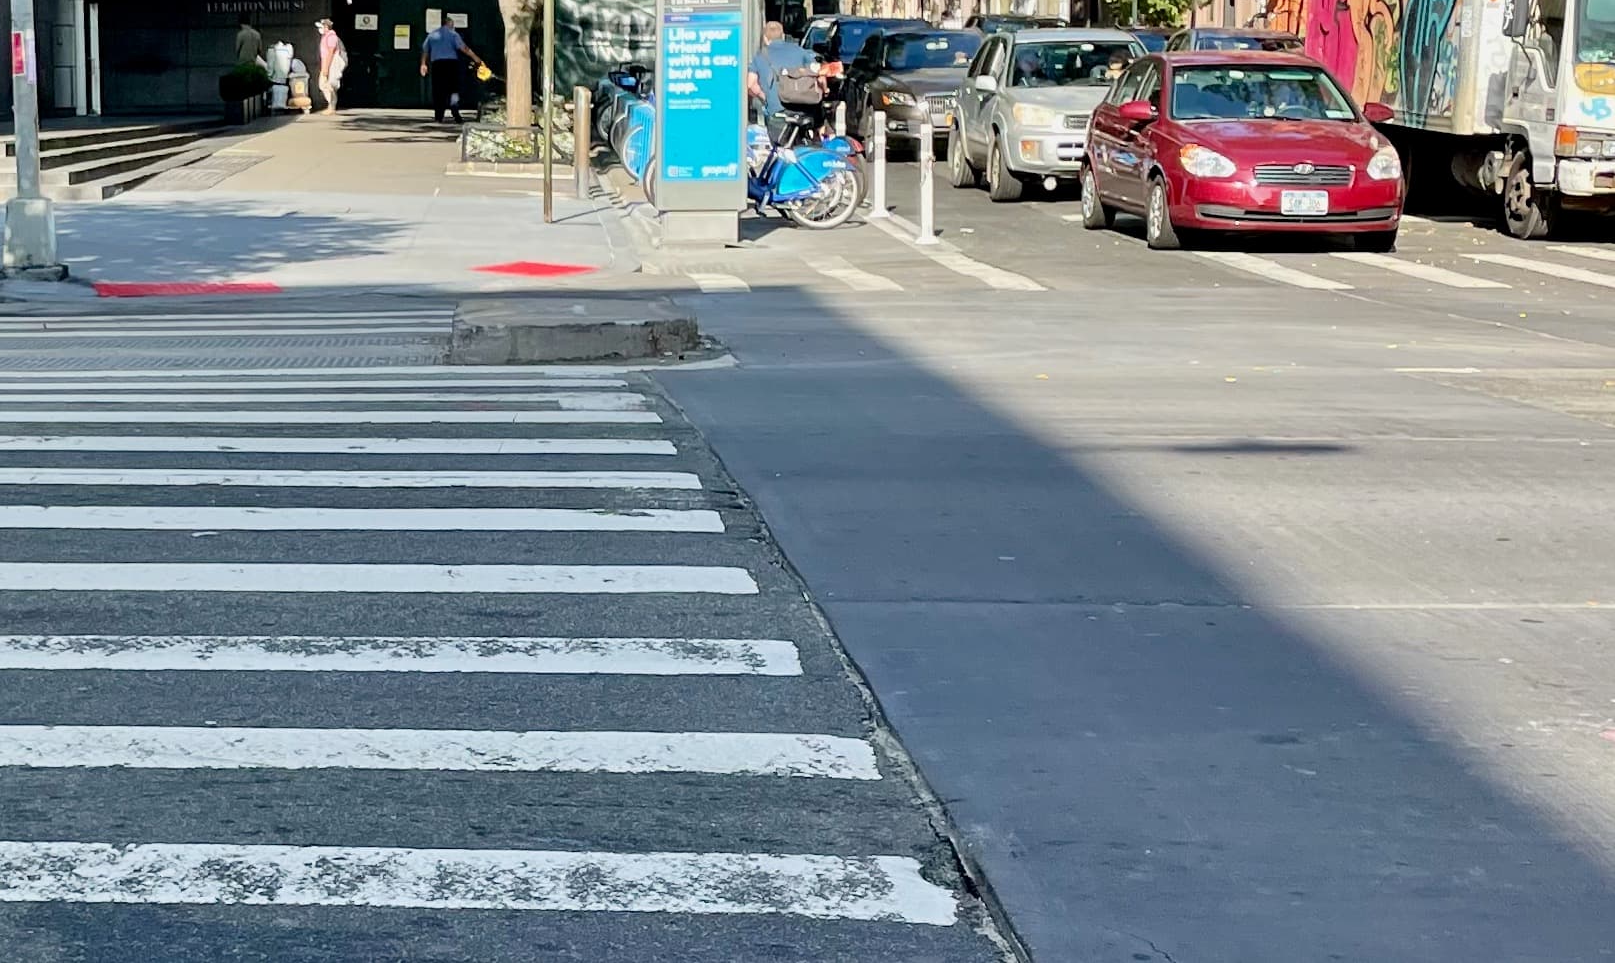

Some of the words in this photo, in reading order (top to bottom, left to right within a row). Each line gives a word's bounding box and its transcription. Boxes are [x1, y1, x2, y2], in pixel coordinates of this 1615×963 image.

[668, 28, 697, 41] Like
[699, 29, 732, 43] your
[668, 40, 711, 54] friend
[668, 53, 700, 67] with
[701, 56, 711, 66] a
[712, 55, 738, 67] car,
[668, 67, 693, 80] but
[694, 68, 713, 79] an
[668, 82, 698, 95] app.
[701, 162, 738, 178] gopuff
